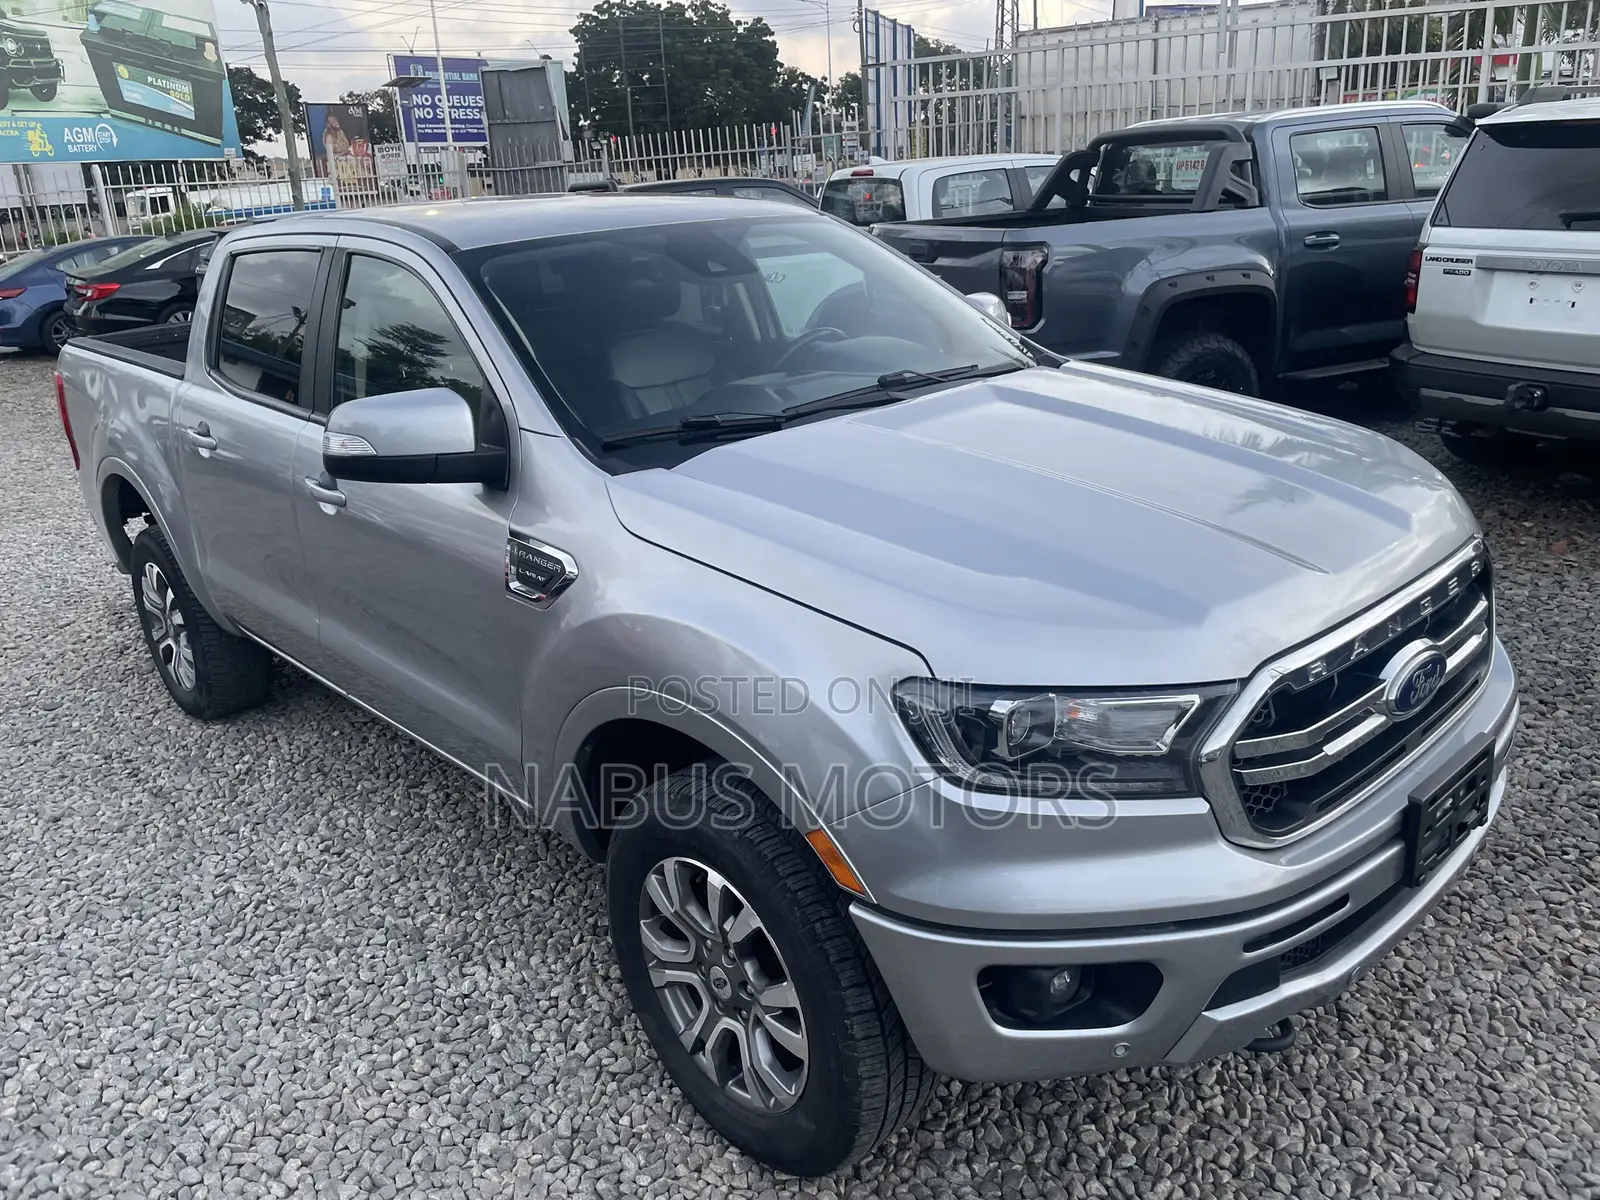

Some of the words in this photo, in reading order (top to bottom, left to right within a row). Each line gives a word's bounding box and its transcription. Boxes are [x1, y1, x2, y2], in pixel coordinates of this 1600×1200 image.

[147, 76, 189, 93] PLATINUM
[169, 90, 190, 101] GOLD
[412, 94, 432, 105] NO
[434, 95, 484, 107] QUEUES
[414, 107, 434, 119] NO
[436, 108, 483, 119] SRESS.
[64, 127, 95, 143] AGM
[68, 144, 97, 153] BATTERY
[1442, 257, 1473, 265] CRUISER
[1521, 259, 1584, 272] TOYOTA
[518, 550, 562, 573] RANGER
[519, 567, 546, 582] LARIAT
[1307, 558, 1483, 682] RANGER
[1410, 663, 1441, 704] Ford
